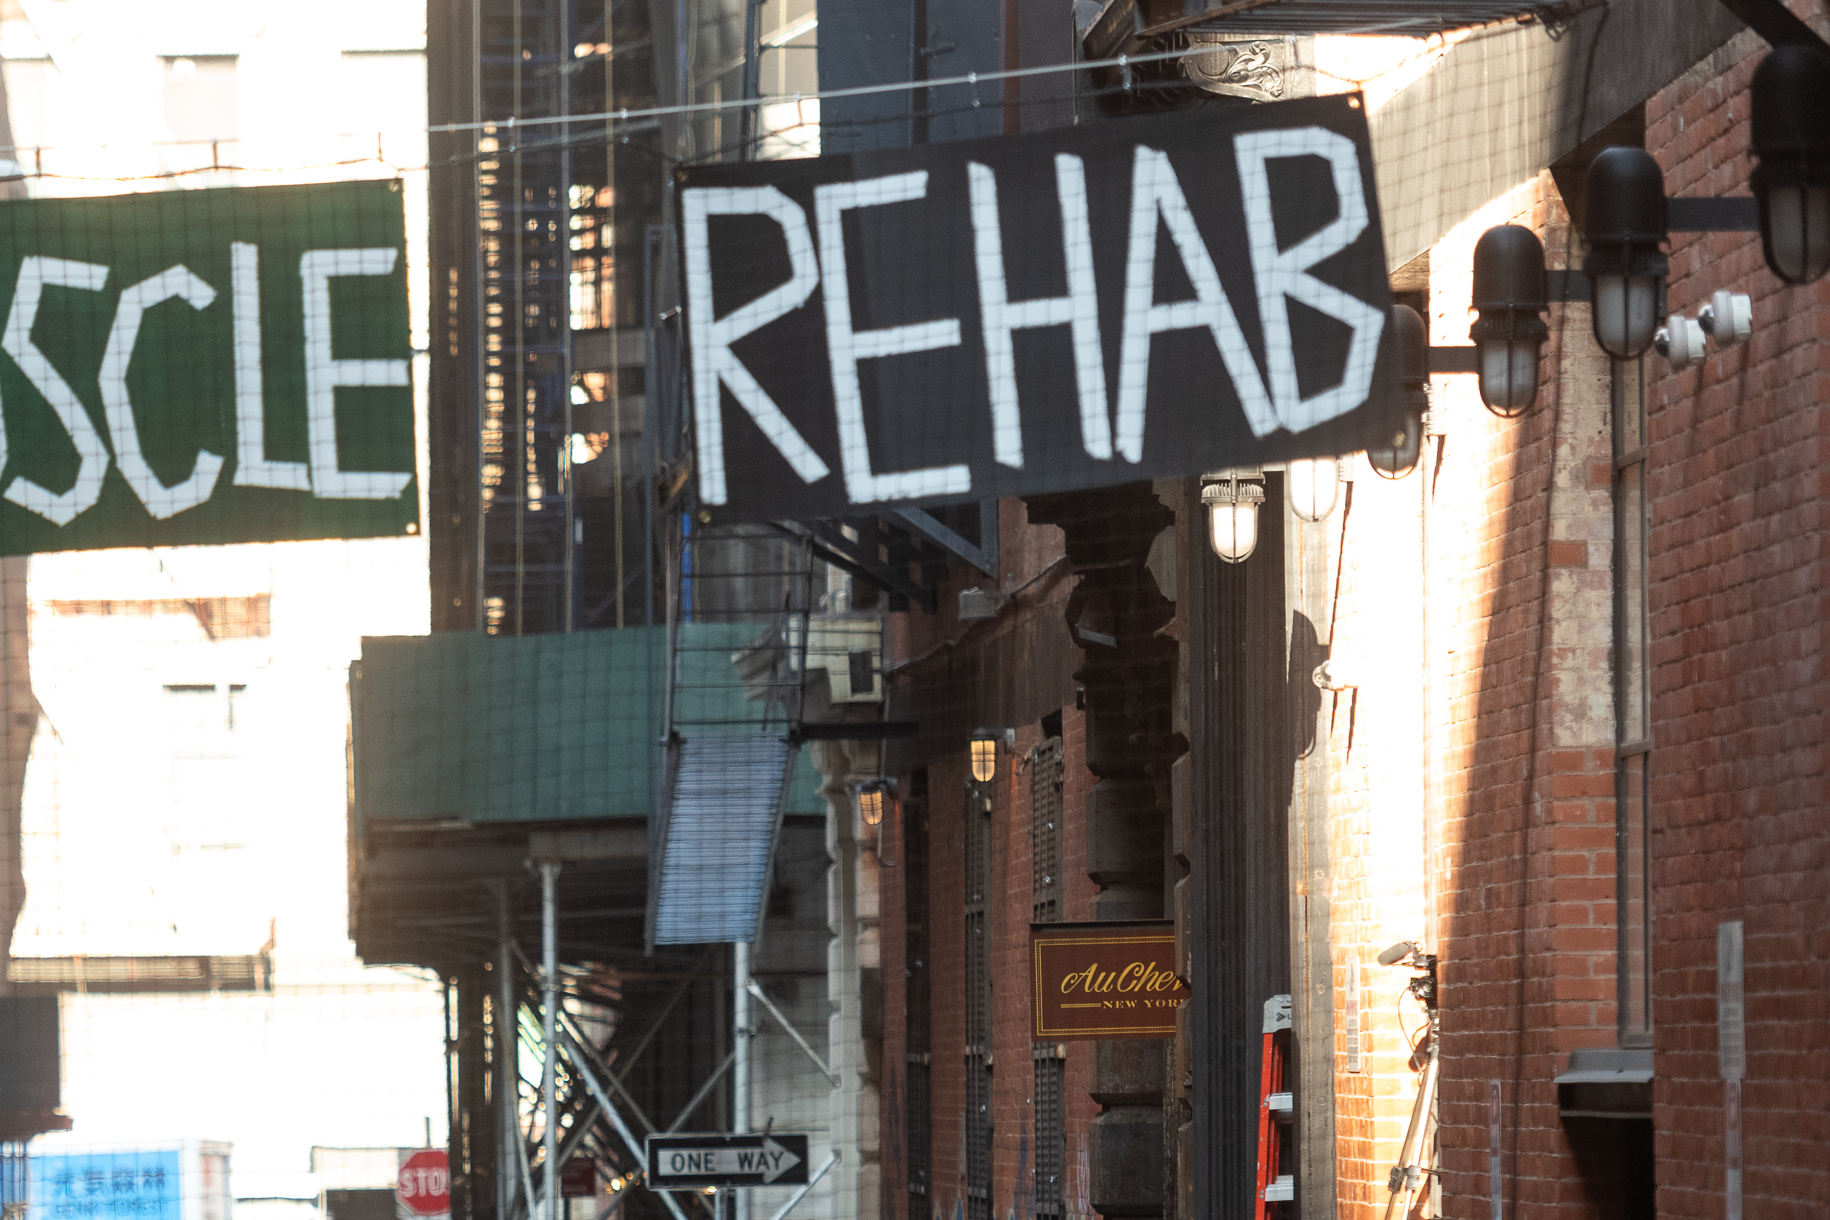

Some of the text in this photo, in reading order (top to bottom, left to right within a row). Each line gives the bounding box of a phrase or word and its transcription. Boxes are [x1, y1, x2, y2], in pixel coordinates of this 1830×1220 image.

[681, 126, 1386, 506] REHAB
[1103, 999, 1184, 1009] NEW YOR
[670, 1151, 786, 1172] ONE WAY
[399, 1167, 447, 1198] STO
